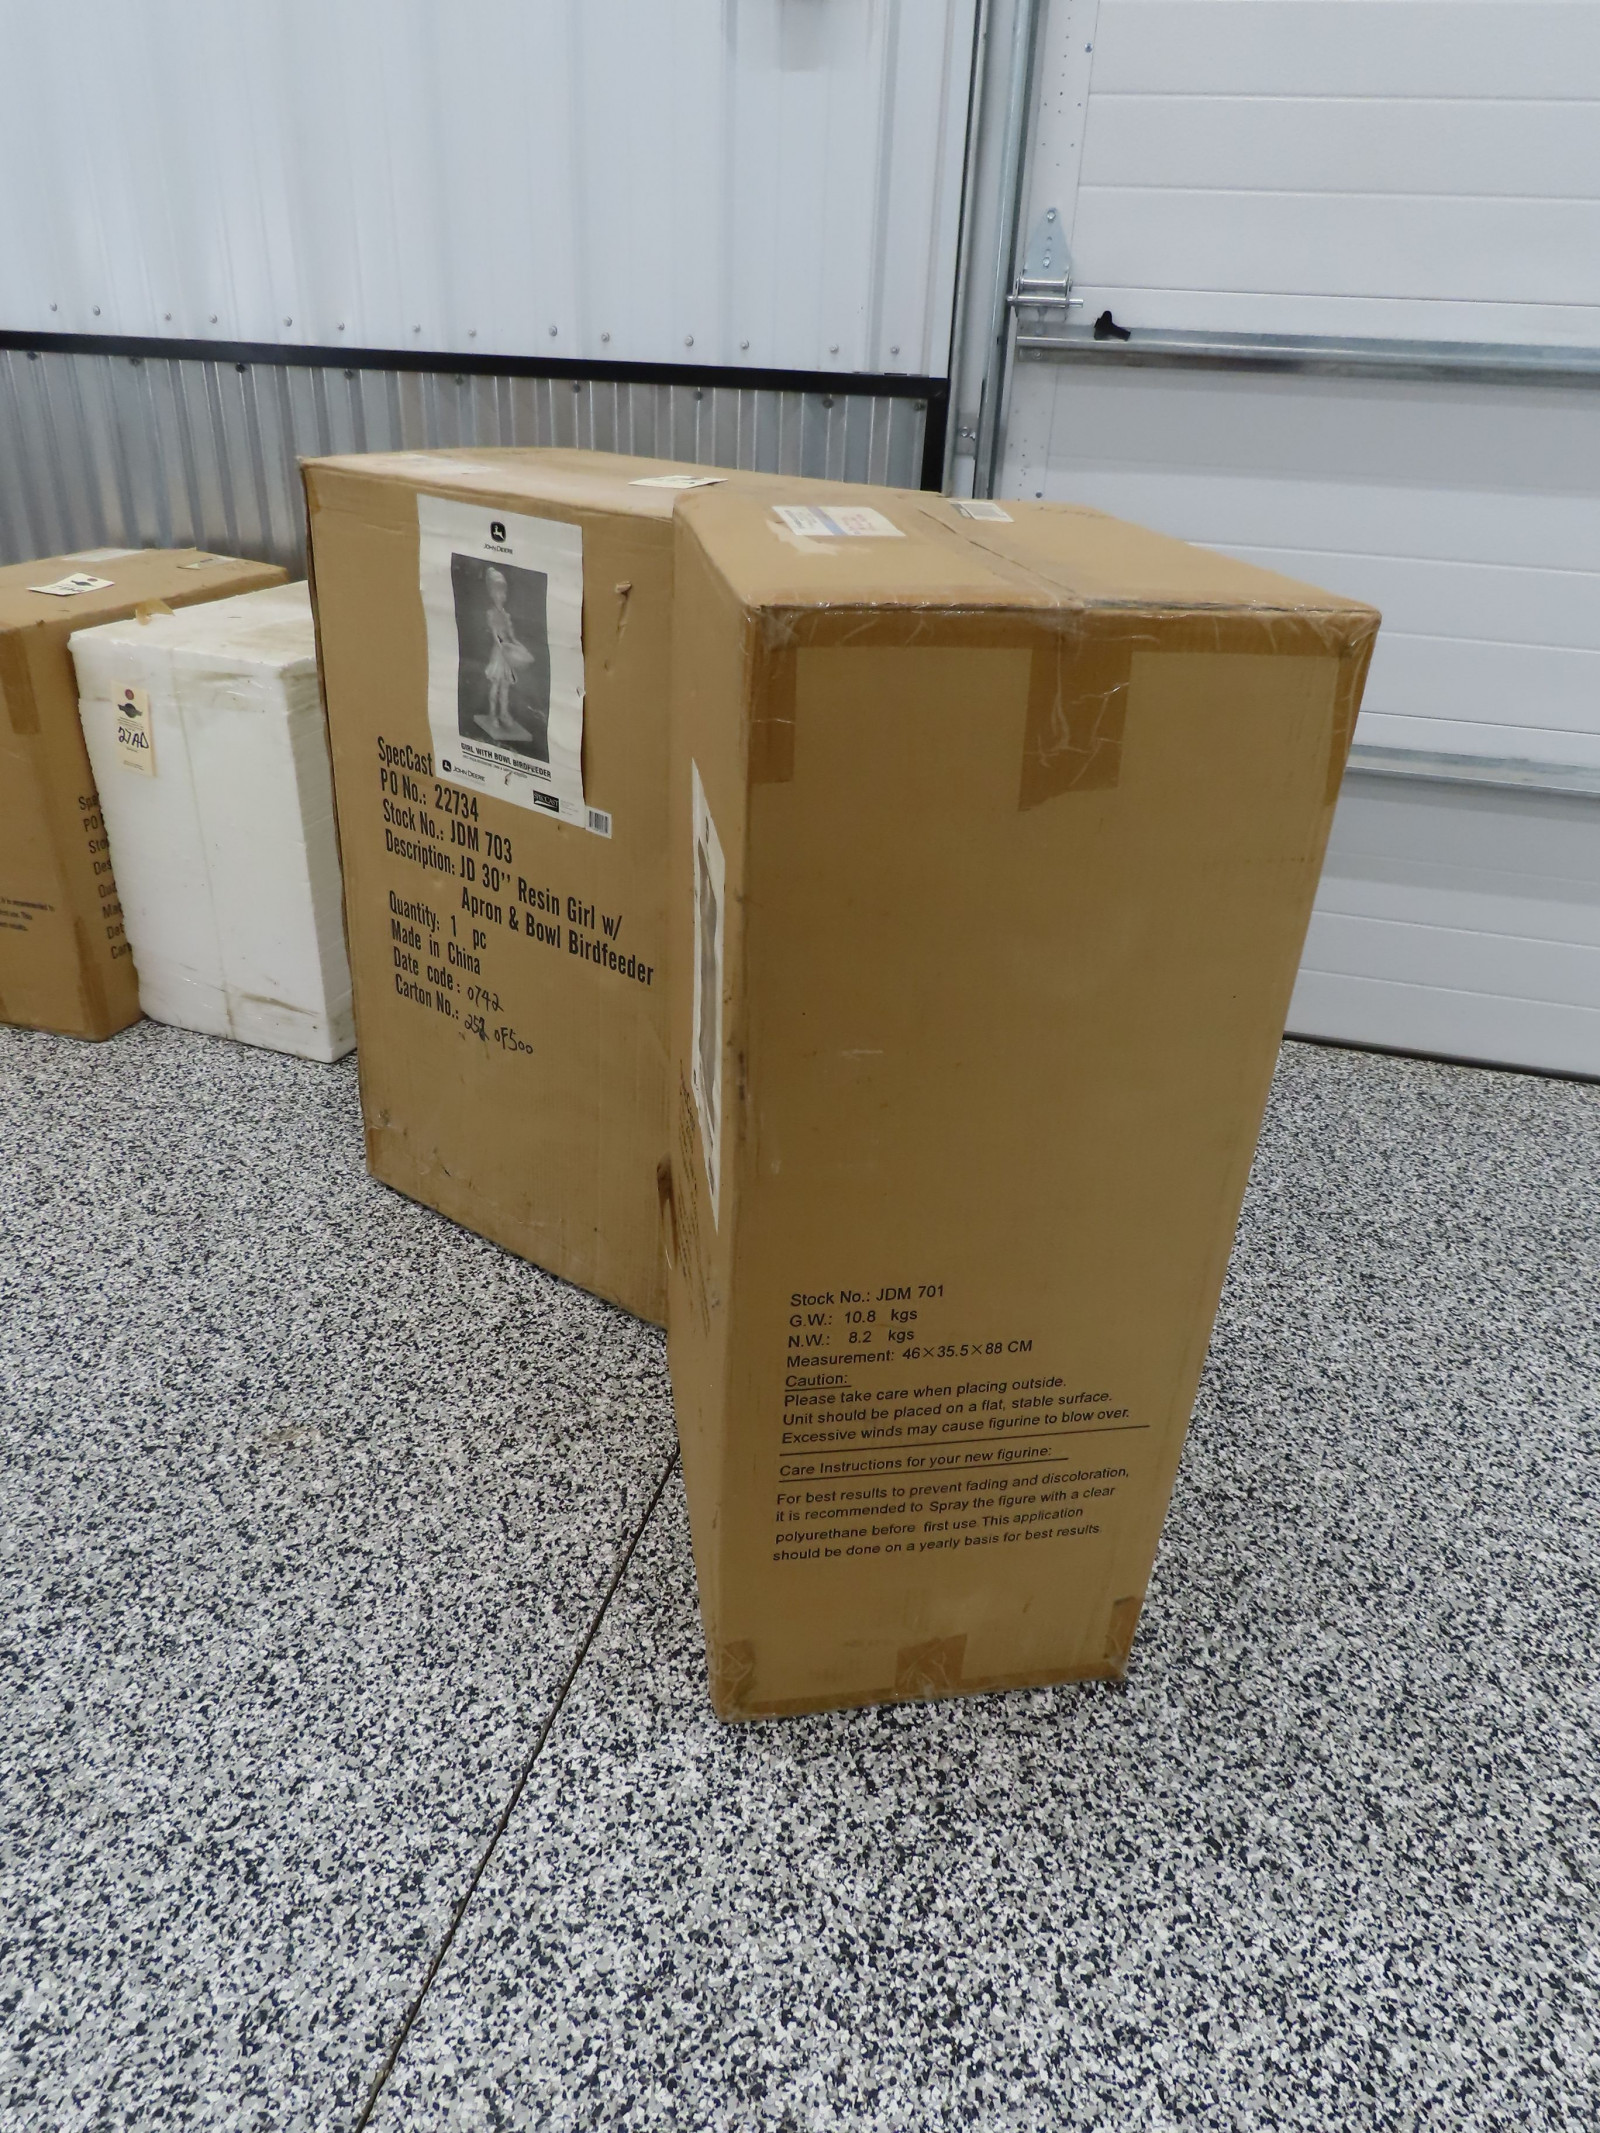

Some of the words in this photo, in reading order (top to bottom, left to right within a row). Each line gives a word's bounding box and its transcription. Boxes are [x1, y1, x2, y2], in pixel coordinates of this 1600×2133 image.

[377, 736, 433, 777] SpecCast
[453, 766, 467, 776] JOHN
[468, 770, 485, 782] DEERE
[461, 743, 474, 752] GIRL
[476, 747, 493, 759] WITH
[494, 753, 511, 764] BOWL
[513, 759, 551, 778] BIRDFEEDER
[380, 767, 398, 794] PO
[403, 775, 427, 805] No.:
[434, 784, 479, 822] 22734
[83, 815, 98, 832] PO
[382, 798, 417, 830] Stock
[420, 809, 444, 840] No.:
[450, 820, 480, 852] JDM
[485, 831, 513, 864] 703
[385, 828, 455, 875] Description:
[460, 856, 476, 881] JD
[518, 877, 560, 916] Resin
[567, 897, 595, 930] Girl
[602, 914, 623, 941] w/
[389, 889, 440, 933] Quantity:
[451, 916, 457, 937] 1
[472, 929, 487, 950] pc
[461, 886, 502, 925] Apron
[508, 906, 519, 931] &
[526, 912, 561, 949] Bowl
[569, 929, 654, 986] Birdfeeder
[391, 919, 421, 950] Made
[429, 934, 440, 957] in
[448, 940, 481, 975] China
[393, 946, 419, 976] Date
[395, 973, 431, 1009] Carton
[436, 989, 459, 1020] No.:
[790, 1291, 834, 1307] Stock
[840, 1289, 870, 1304] No.:
[876, 1287, 911, 1302] JDM
[918, 1285, 944, 1300] 701
[789, 1313, 833, 1327] G.W.:
[845, 1310, 876, 1324] 10.8
[891, 1308, 918, 1322] kgs
[786, 1350, 895, 1368] Measurement:
[1008, 1340, 1033, 1354] CM
[788, 1334, 830, 1348] N.W.:
[848, 1331, 871, 1344] 8.2
[888, 1329, 914, 1343] kgs
[784, 1392, 836, 1407] Please
[840, 1389, 871, 1403] take
[876, 1389, 907, 1401] care
[912, 1384, 952, 1398] when
[956, 1379, 1007, 1396] placing
[1012, 1375, 1067, 1390] outside.
[785, 1373, 848, 1388] Caution:
[782, 1427, 857, 1444] Excessive
[861, 1424, 903, 1438] winds
[907, 1423, 937, 1439] may
[941, 1419, 984, 1434] cause
[988, 1413, 1041, 1431] figurine
[1044, 1412, 1058, 1425] to
[1061, 1410, 1094, 1423] blow
[1097, 1407, 1130, 1420] over.
[783, 1411, 813, 1425] Unit
[817, 1407, 866, 1423] should
[870, 1405, 889, 1420] be
[893, 1402, 942, 1420] placed
[946, 1402, 964, 1414] on
[968, 1402, 977, 1412] a
[981, 1396, 1006, 1412] flat,
[1011, 1393, 1053, 1409] stable
[1058, 1389, 1112, 1405] surface.
[780, 1462, 815, 1477] Care
[820, 1455, 902, 1474] Instructions
[907, 1454, 925, 1468] for
[928, 1451, 961, 1468] your
[964, 1449, 993, 1462] new
[996, 1445, 1052, 1466] figurine:
[775, 1510, 785, 1522] it
[788, 1509, 800, 1521] is
[804, 1501, 906, 1520] recommended
[910, 1499, 924, 1513] to
[928, 1496, 970, 1515] Spray
[973, 1495, 994, 1508] the
[998, 1490, 1036, 1508] figure
[1040, 1488, 1067, 1502] with
[1071, 1489, 1080, 1499] a
[1082, 1484, 1116, 1498] clear
[777, 1492, 801, 1505] For
[805, 1490, 836, 1504] best
[840, 1485, 887, 1501] results
[891, 1484, 905, 1497] to
[909, 1481, 962, 1498] prevent
[966, 1476, 1009, 1494] fading
[1012, 1474, 1039, 1487] and
[1042, 1465, 1130, 1486] discoloration,
[773, 1545, 821, 1561] should
[824, 1542, 843, 1557] be
[846, 1540, 882, 1556] done
[885, 1538, 903, 1552] on
[906, 1540, 916, 1551] a
[919, 1533, 961, 1552] yearly
[964, 1529, 1000, 1547] basis
[1003, 1527, 1022, 1542] for
[1025, 1524, 1053, 1540] best
[775, 1522, 868, 1544] polyurethane
[871, 1518, 916, 1535] before
[923, 1516, 950, 1532] first
[982, 1510, 1010, 1526] This
[1012, 1504, 1084, 1525] application
